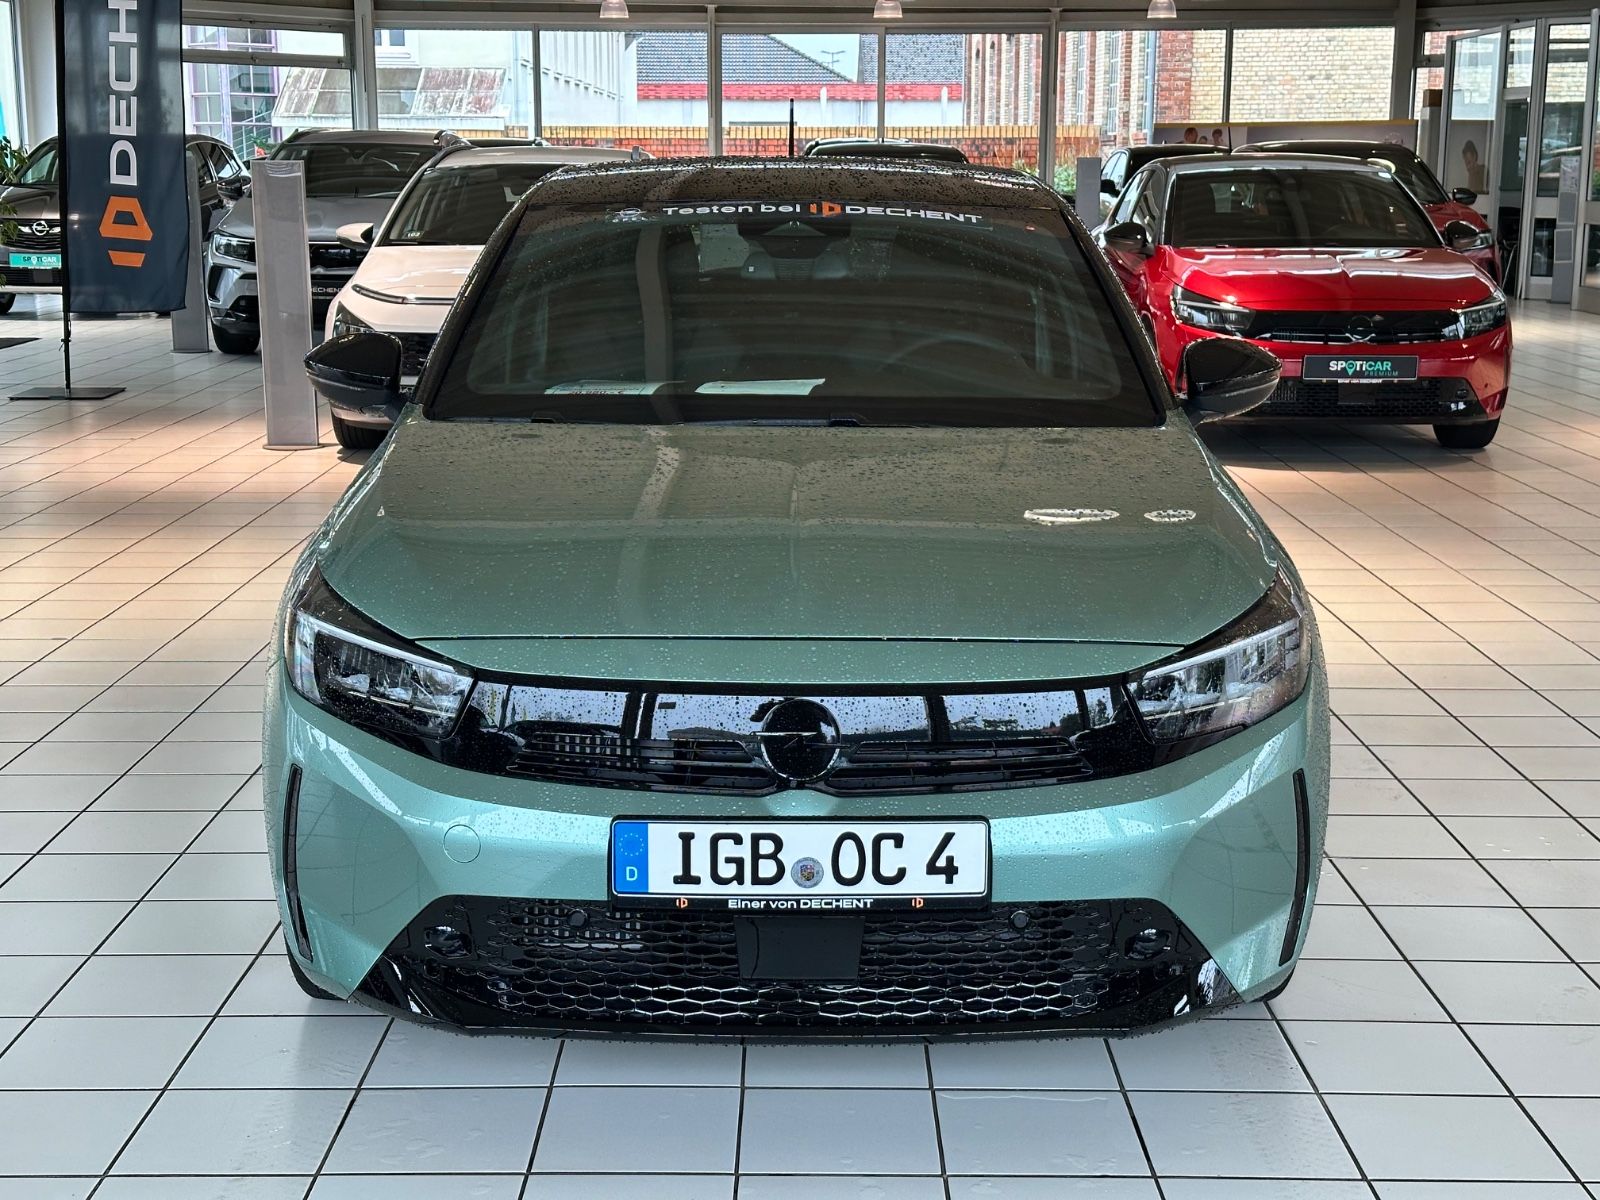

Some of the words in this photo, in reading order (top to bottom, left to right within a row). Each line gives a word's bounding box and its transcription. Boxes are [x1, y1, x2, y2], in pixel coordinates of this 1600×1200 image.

[108, 0, 138, 186] DECH
[662, 205, 753, 216] Testen
[760, 203, 801, 213] bei
[845, 205, 983, 224] DECHENT
[673, 831, 786, 886] IGB
[831, 831, 907, 887] OC
[925, 831, 959, 885] 4
[625, 866, 638, 881] D
[728, 898, 766, 909] Einer
[769, 900, 797, 909] von
[799, 898, 874, 909] DECHENT
